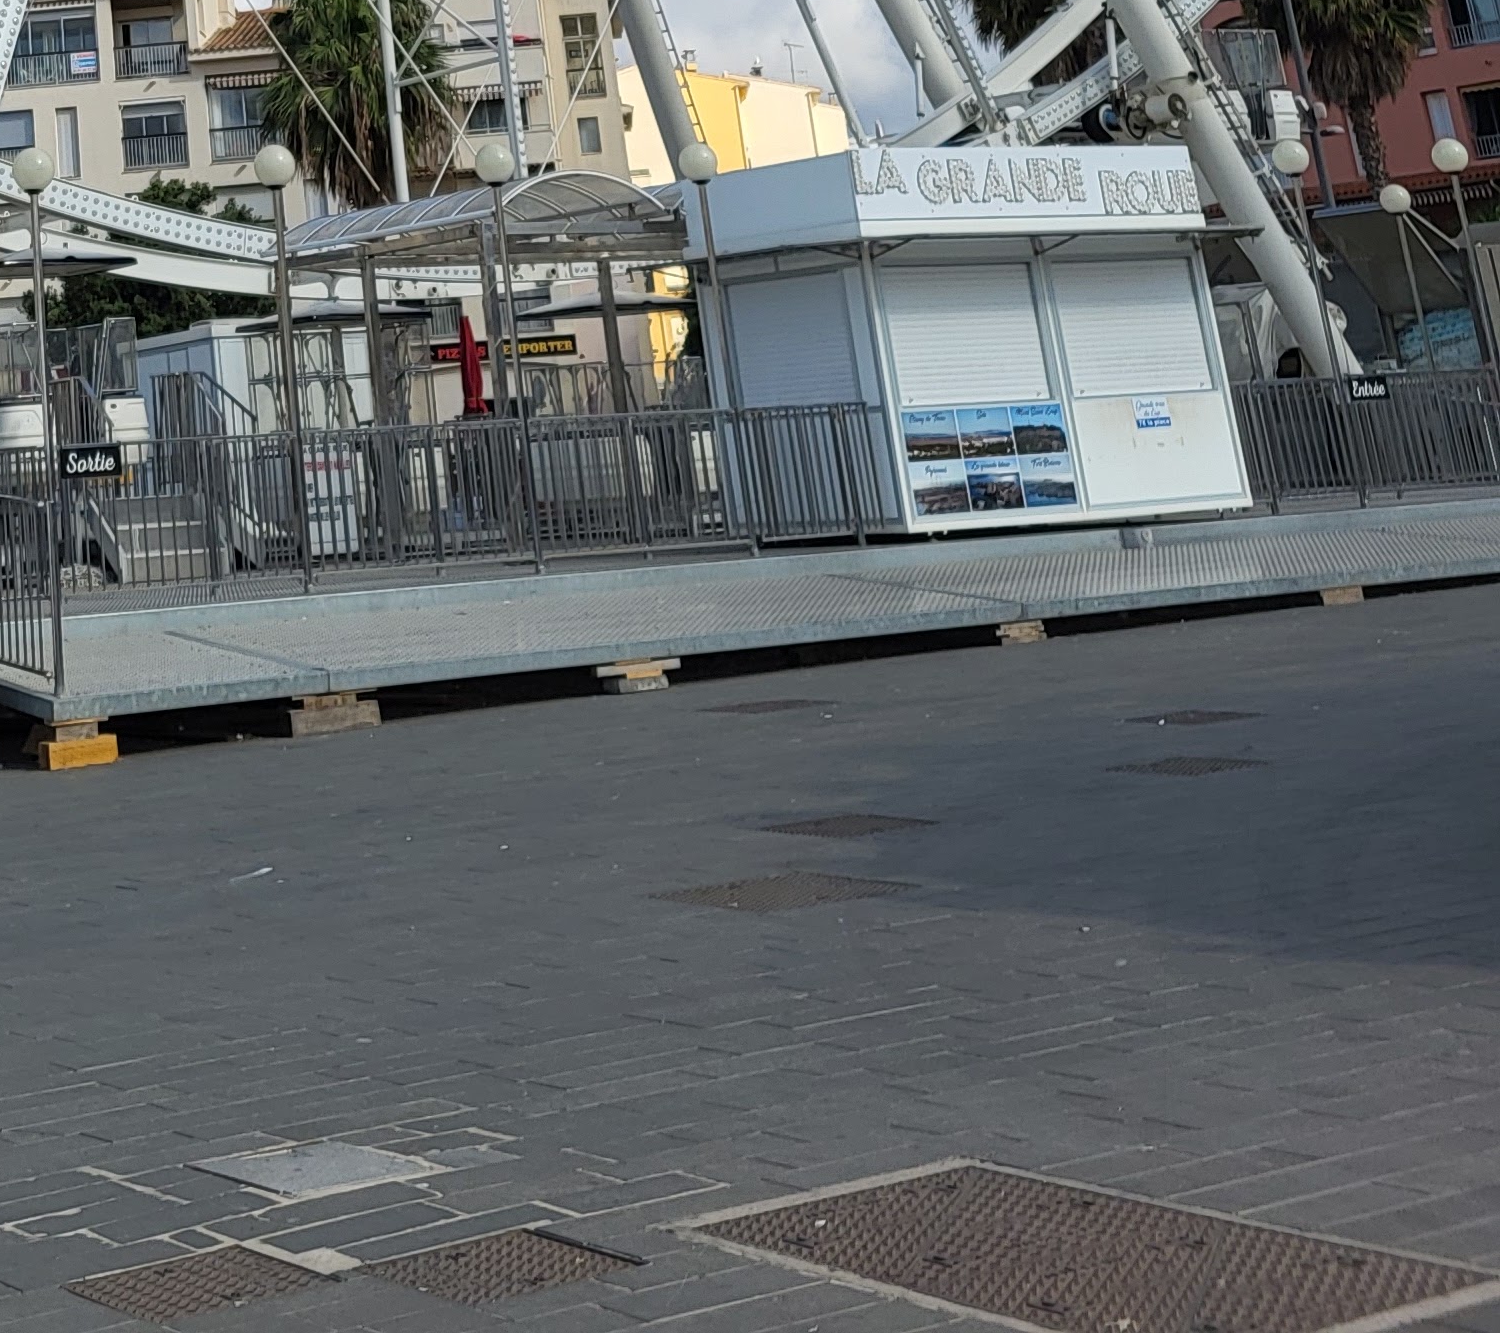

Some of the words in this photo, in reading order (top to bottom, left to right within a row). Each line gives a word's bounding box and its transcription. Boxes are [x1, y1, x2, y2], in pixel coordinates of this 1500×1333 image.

[850, 149, 909, 195] LA
[916, 156, 1088, 205] GRANDE
[1098, 169, 1201, 215] ROUE
[438, 346, 486, 360] PIZS
[1353, 380, 1386, 397] Entrée
[66, 450, 116, 474] Sortie
